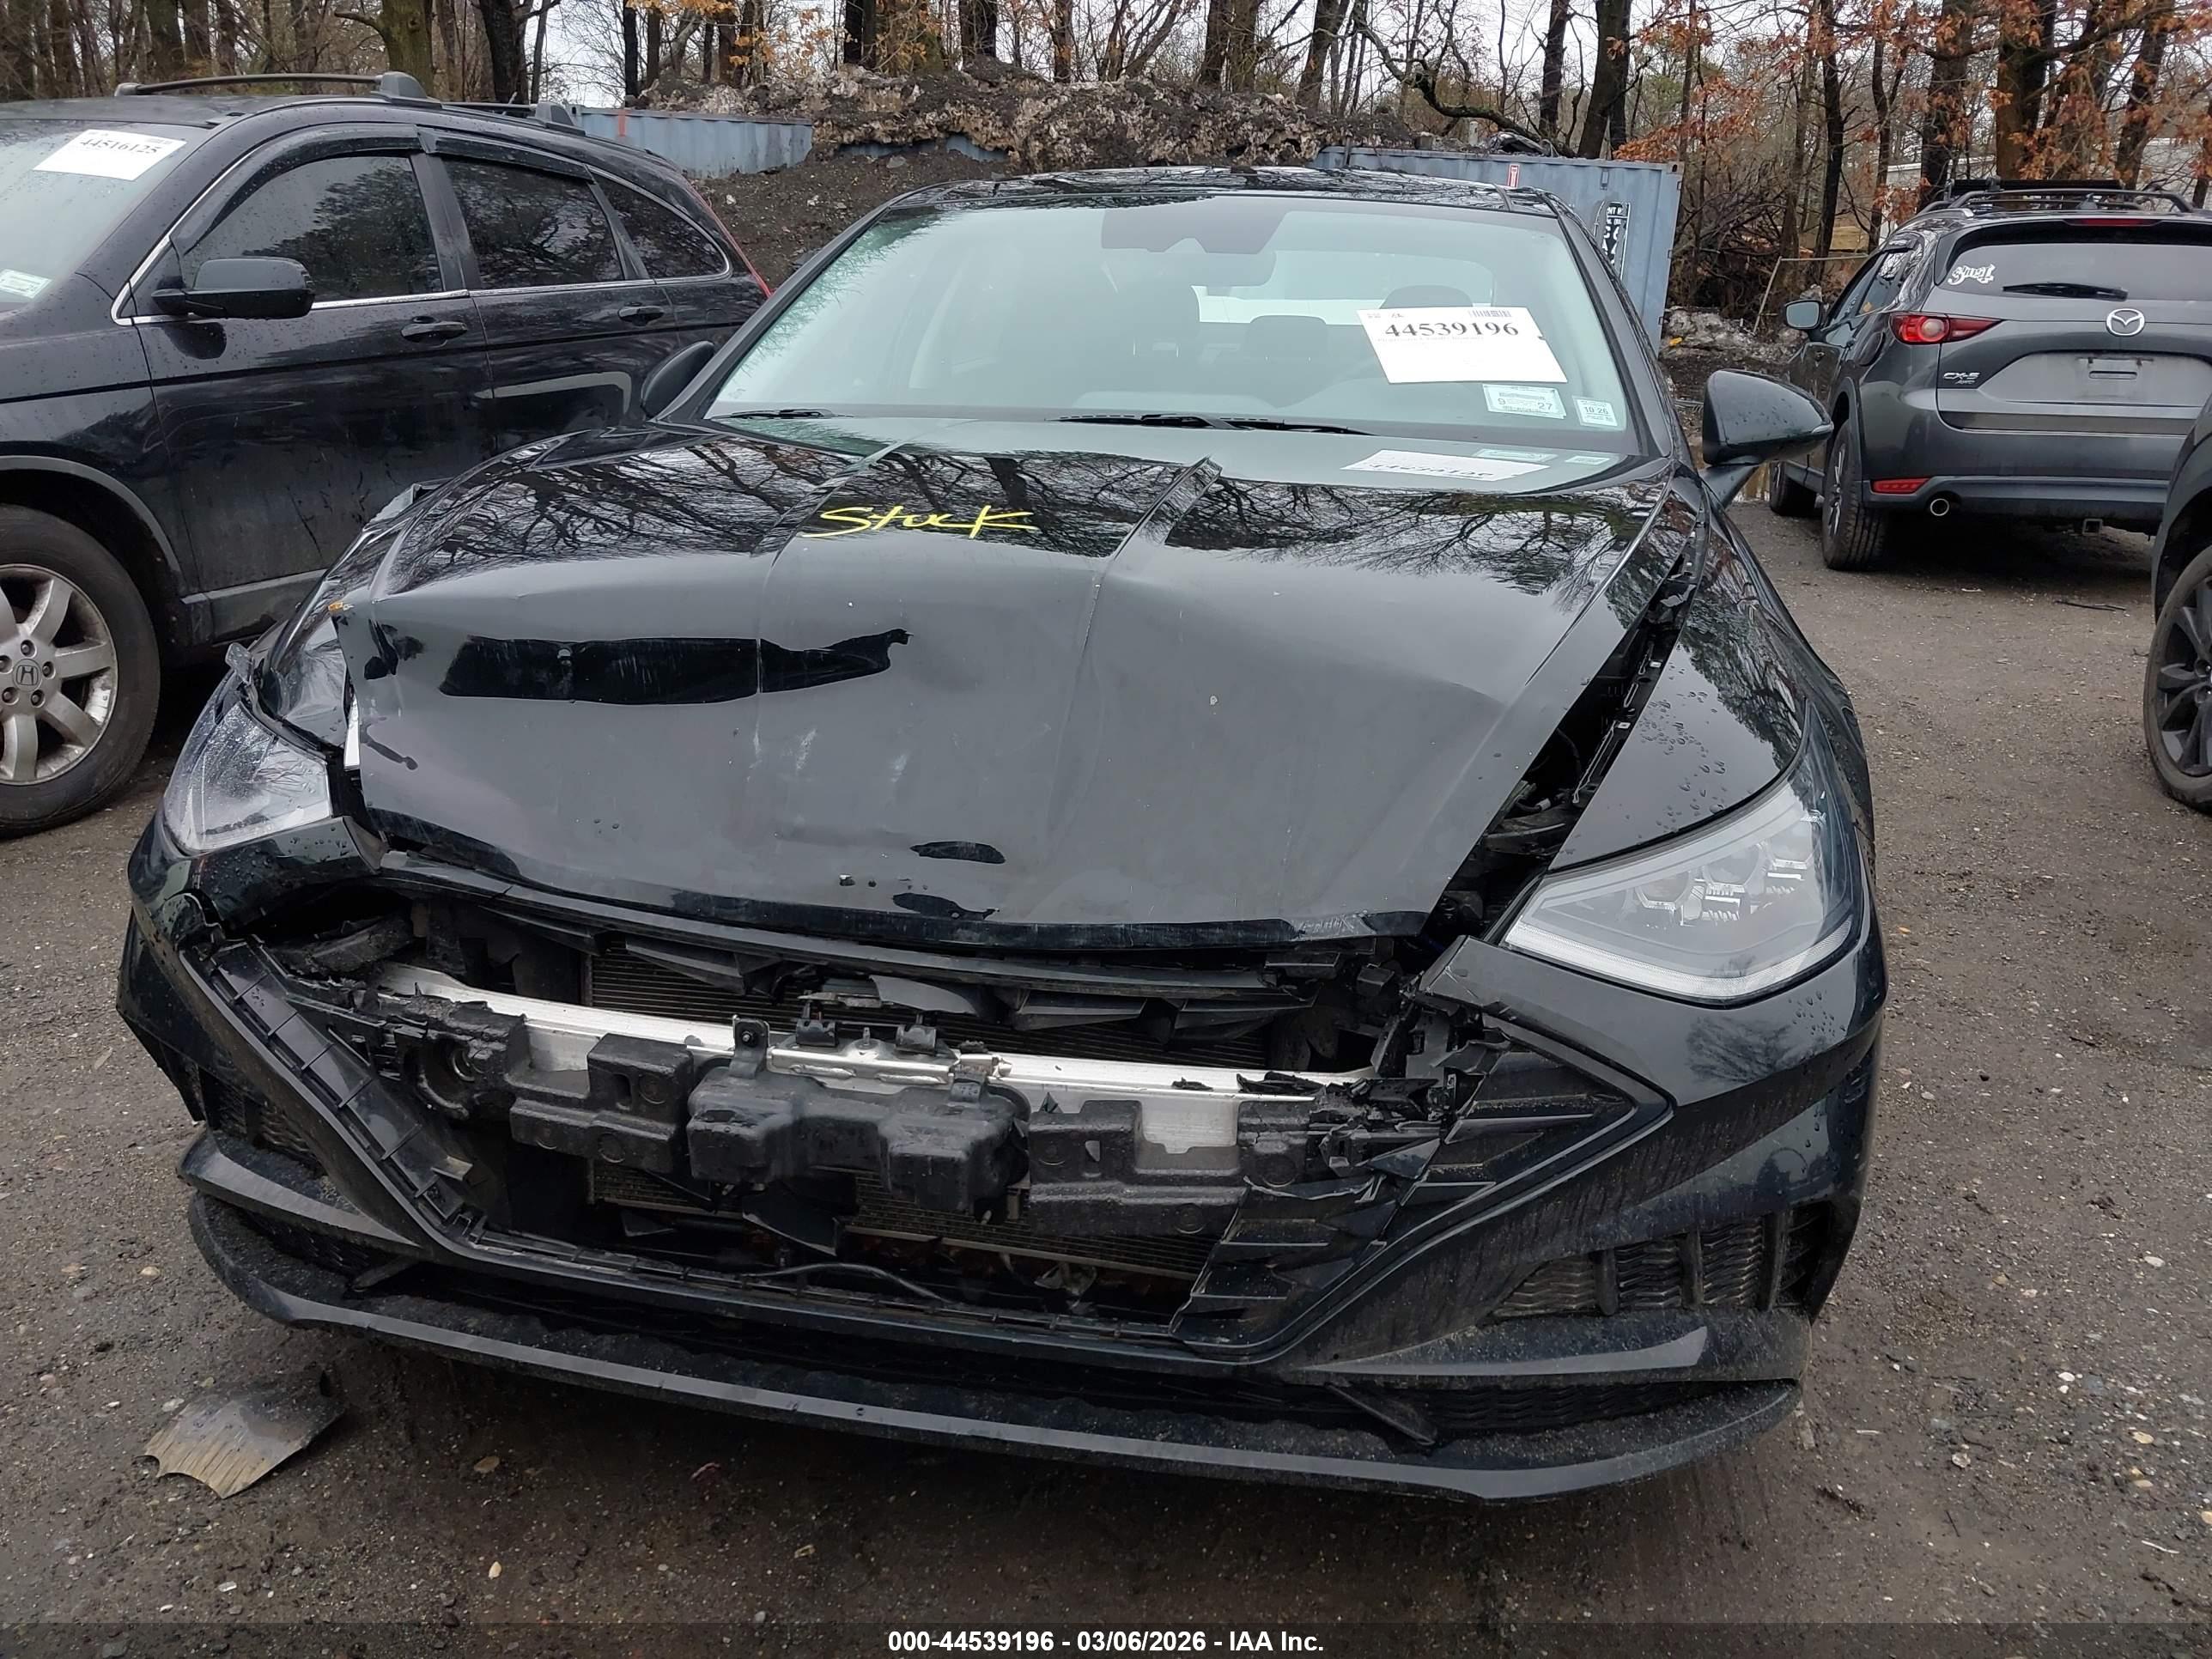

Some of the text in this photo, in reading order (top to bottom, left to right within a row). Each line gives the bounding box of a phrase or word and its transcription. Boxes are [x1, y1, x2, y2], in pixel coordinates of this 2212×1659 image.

[80, 138, 162, 154] 44516125
[1384, 321, 1519, 337] 44539196
[1537, 402, 1553, 410] 27
